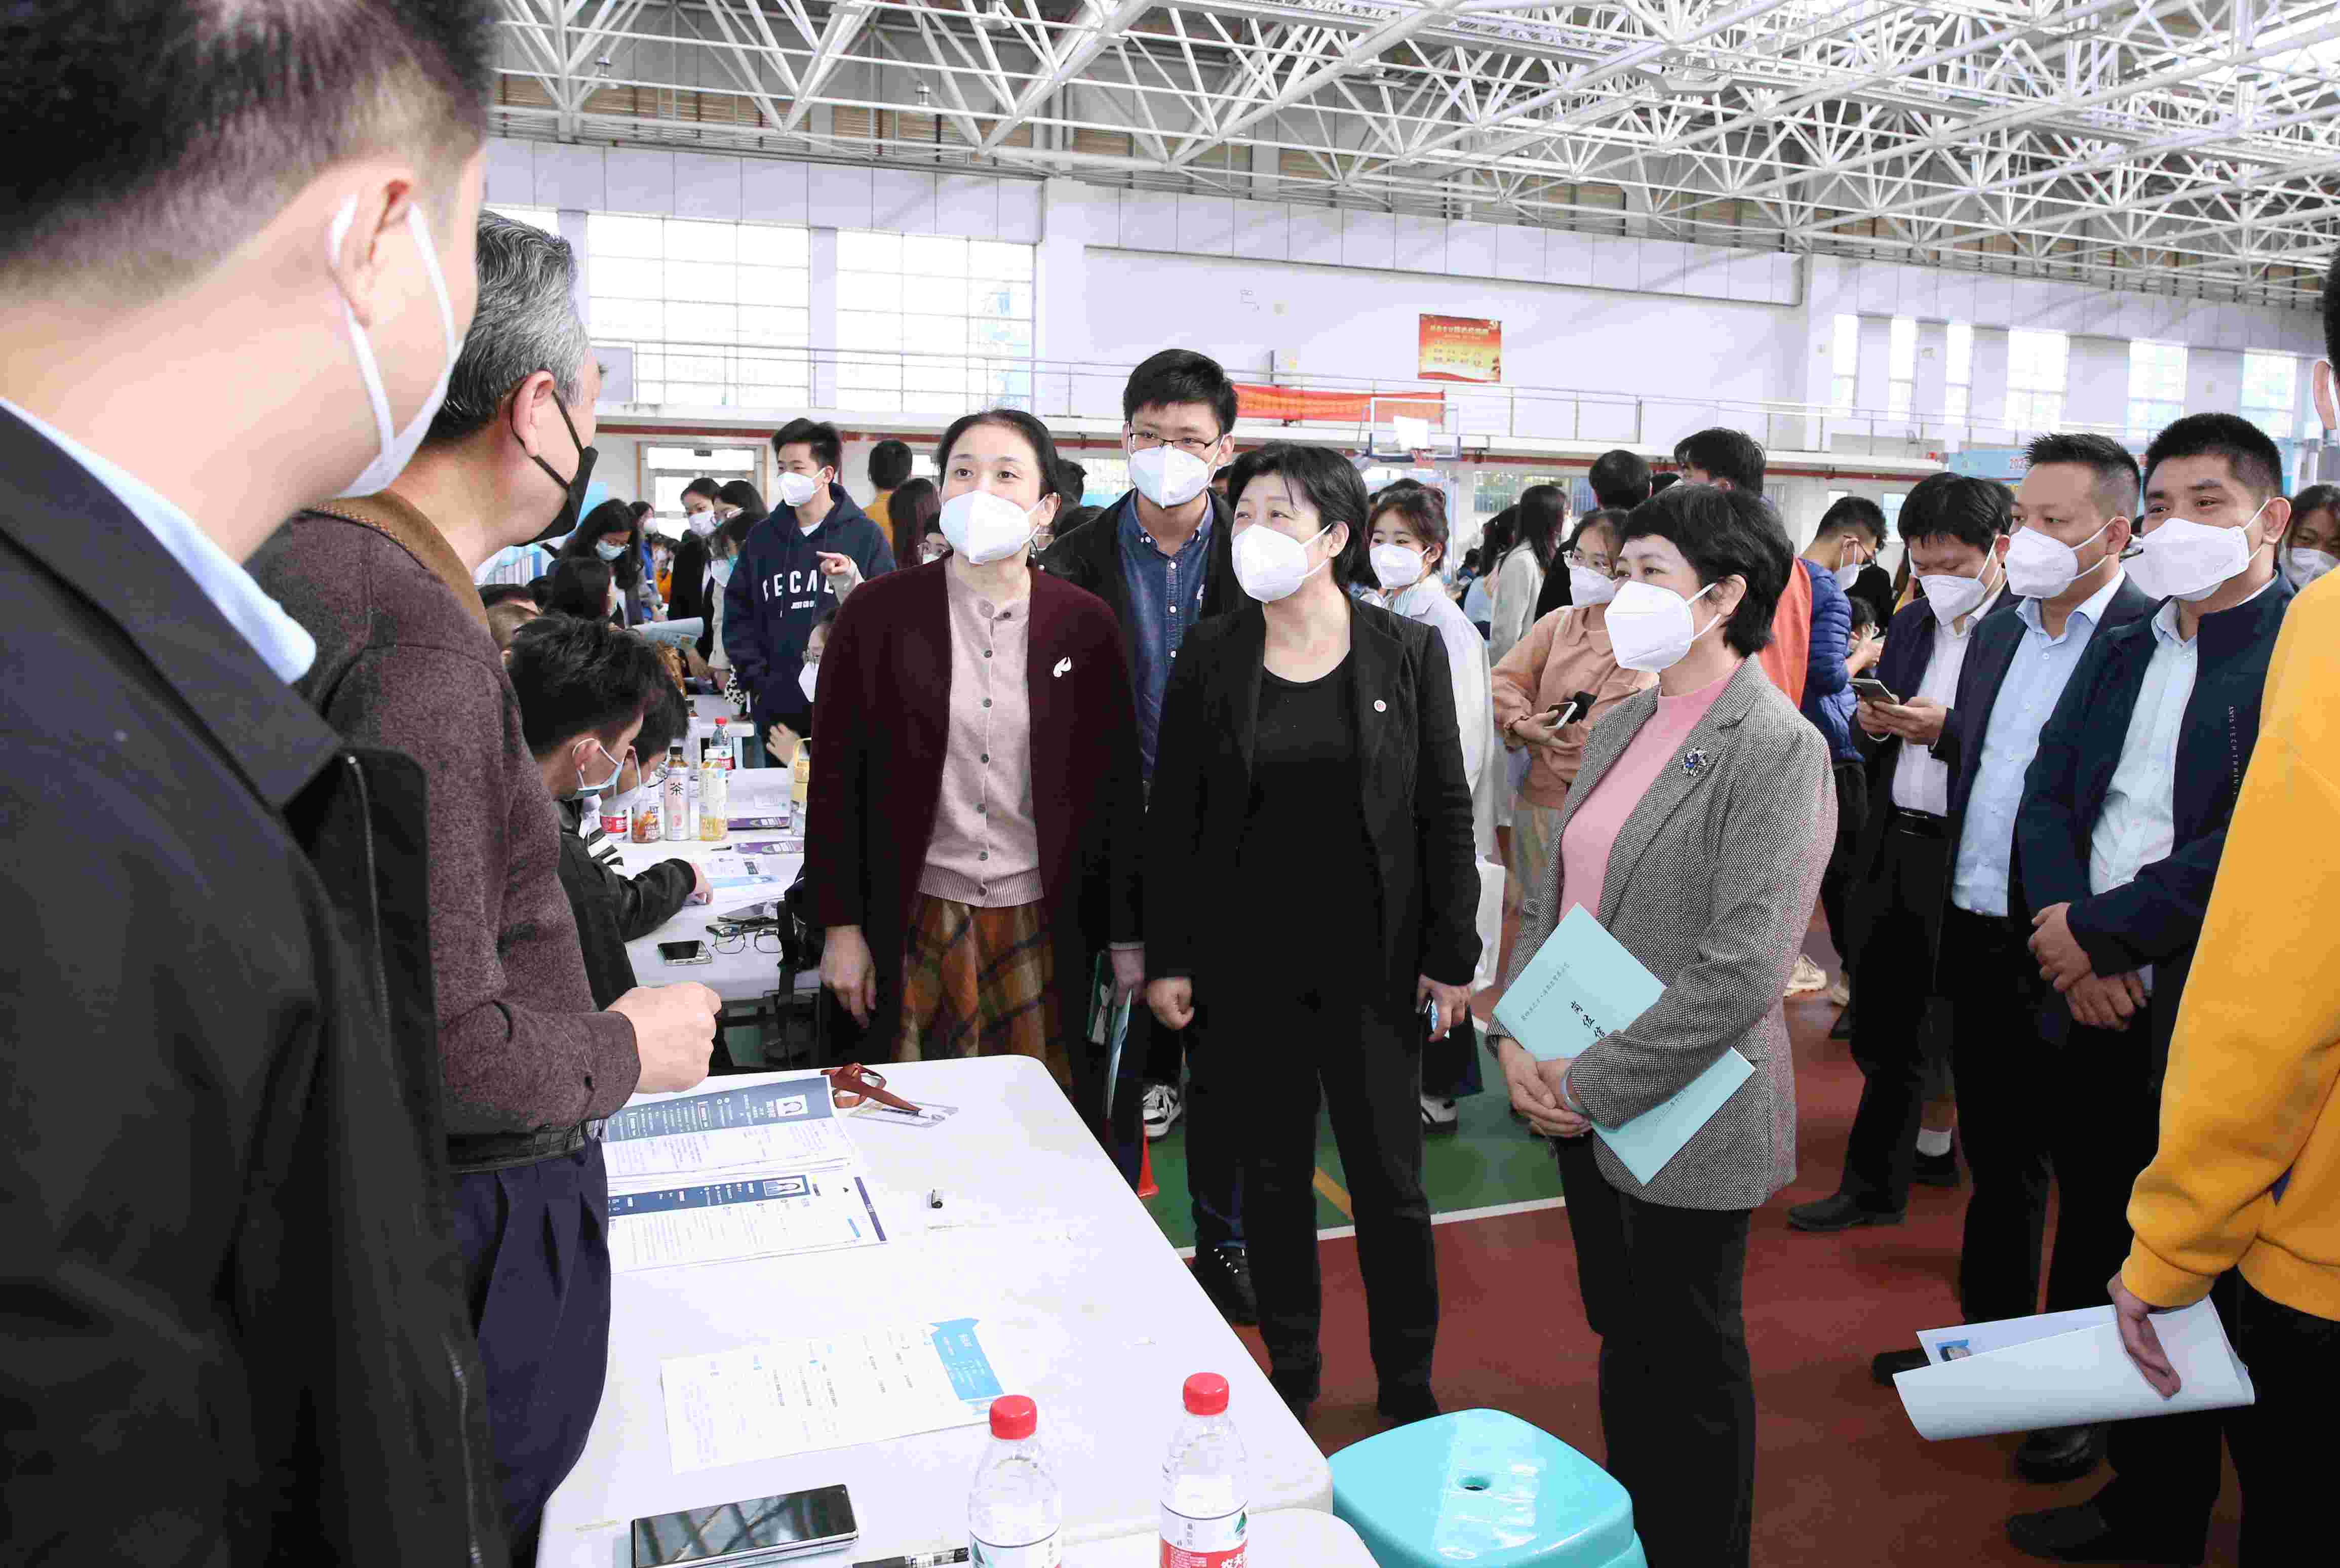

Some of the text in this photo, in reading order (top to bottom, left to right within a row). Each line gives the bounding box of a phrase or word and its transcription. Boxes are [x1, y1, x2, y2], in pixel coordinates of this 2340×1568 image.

[670, 782, 684, 796] 茶
[1570, 1000, 1606, 1039] 岗位信
